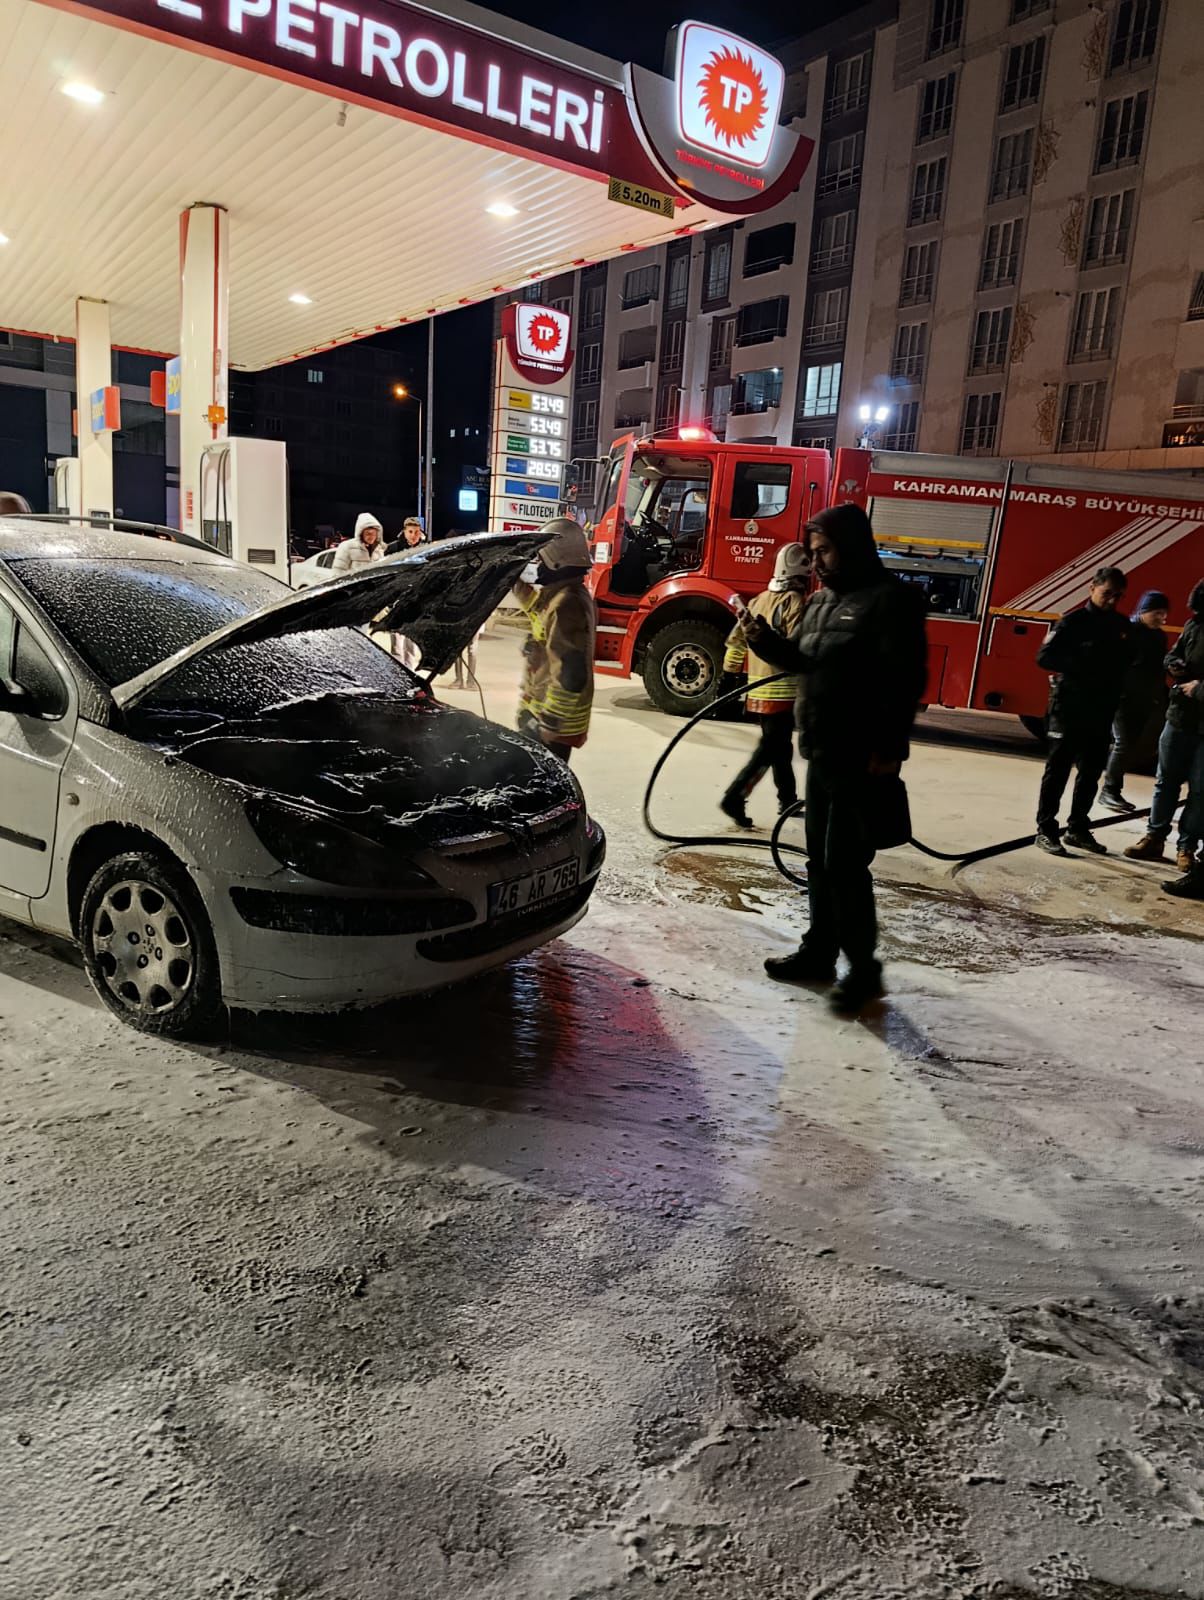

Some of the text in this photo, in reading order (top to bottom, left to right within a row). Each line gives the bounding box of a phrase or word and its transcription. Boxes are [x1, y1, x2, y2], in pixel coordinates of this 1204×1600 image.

[719, 75, 753, 114] TP
[622, 186, 661, 210] 5.20m
[537, 325, 555, 341] TP
[1085, 496, 1204, 520] BÜYÜKŞEHİ
[743, 545, 764, 557] 112
[498, 884, 519, 911] 46
[528, 875, 546, 902] AR
[552, 862, 577, 893] 765
